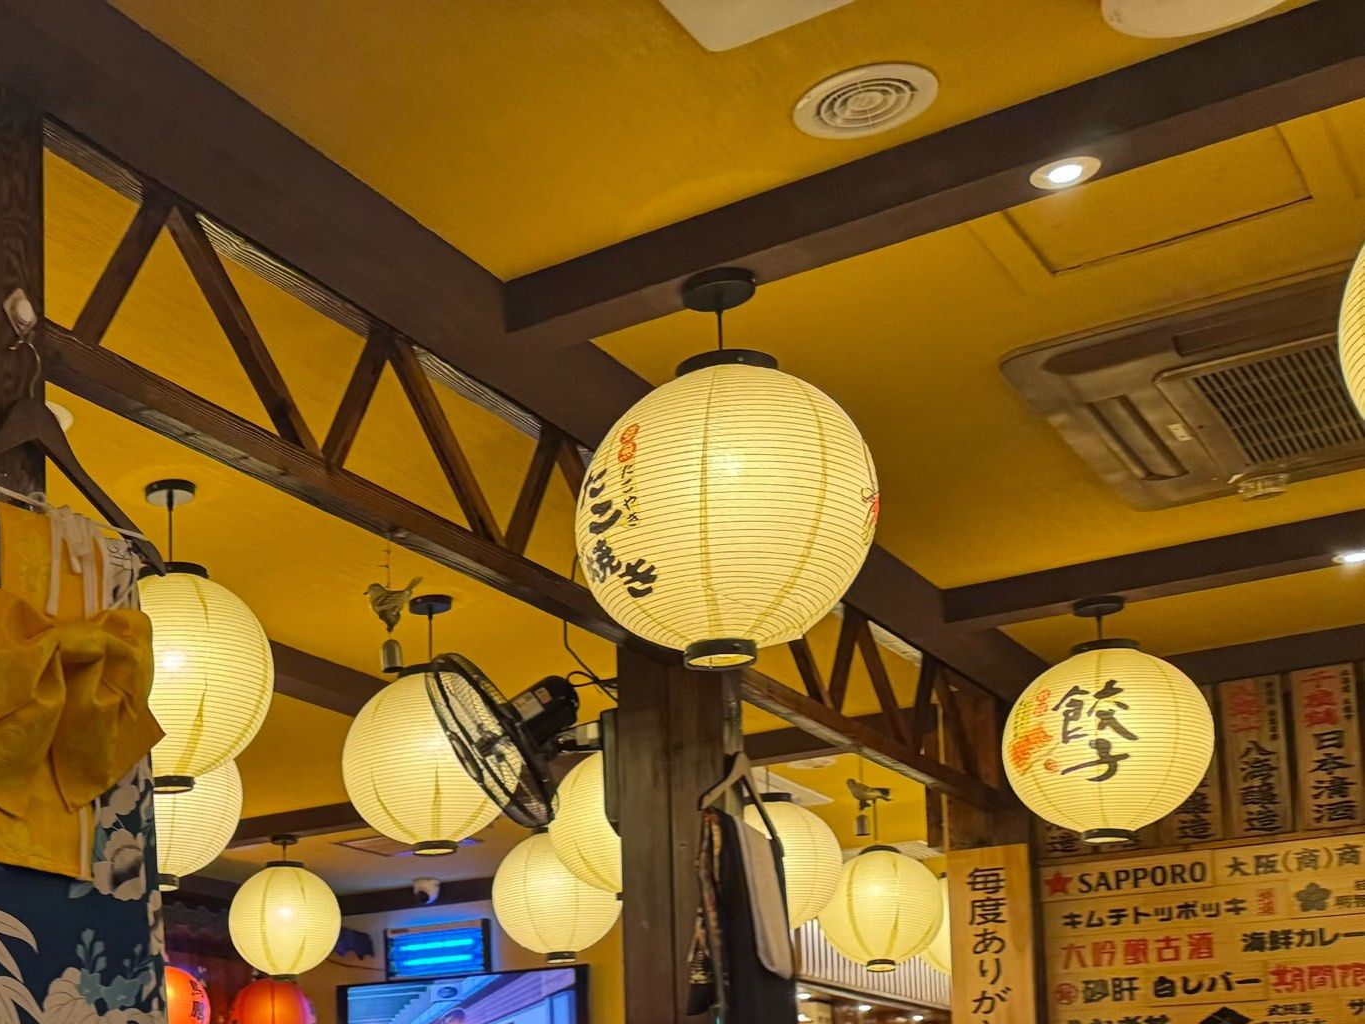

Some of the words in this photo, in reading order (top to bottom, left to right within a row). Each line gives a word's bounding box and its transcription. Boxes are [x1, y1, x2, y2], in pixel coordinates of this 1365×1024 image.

[1051, 679, 1140, 783] 餃子
[1308, 729, 1357, 824] 日本清酒
[1077, 861, 1208, 894] SAPPORO
